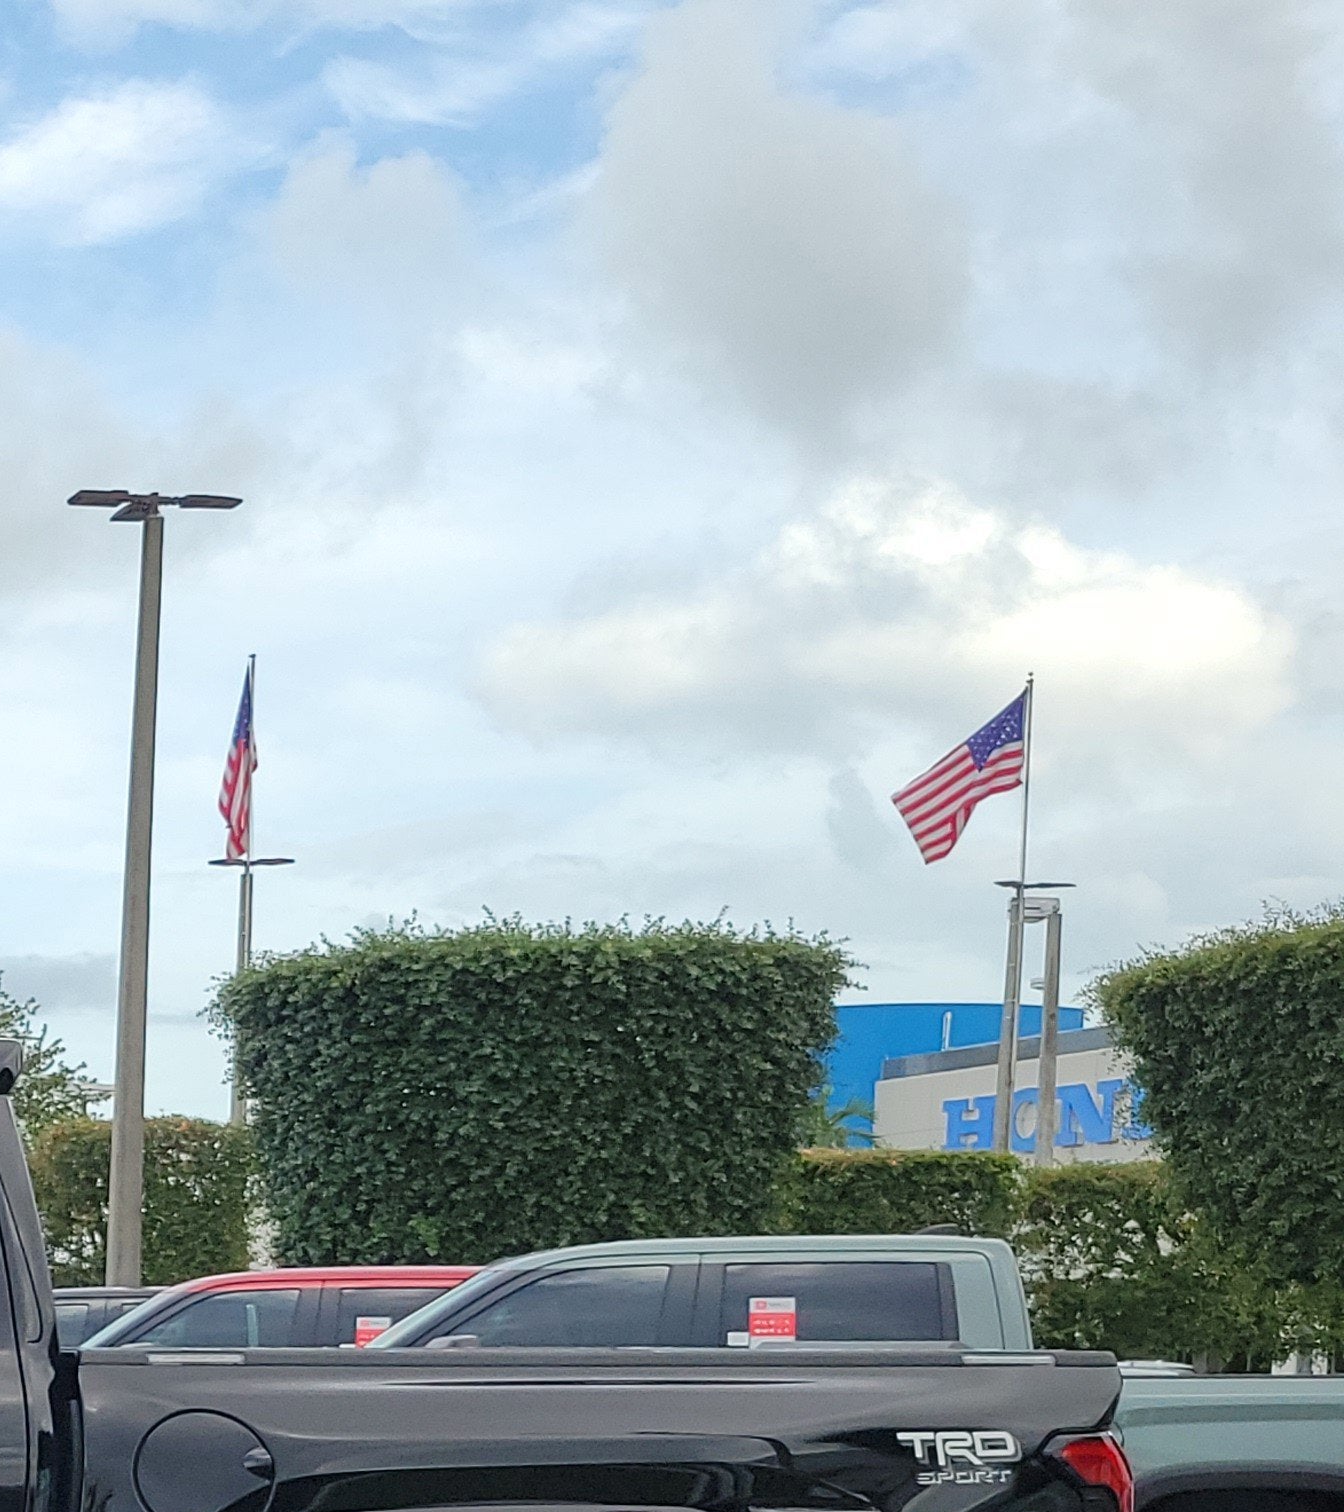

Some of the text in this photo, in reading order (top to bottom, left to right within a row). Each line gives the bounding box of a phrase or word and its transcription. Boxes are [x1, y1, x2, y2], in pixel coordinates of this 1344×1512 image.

[942, 1079, 1154, 1153] HON
[896, 1431, 1018, 1467] TRD
[916, 1470, 1012, 1485] SPORT
